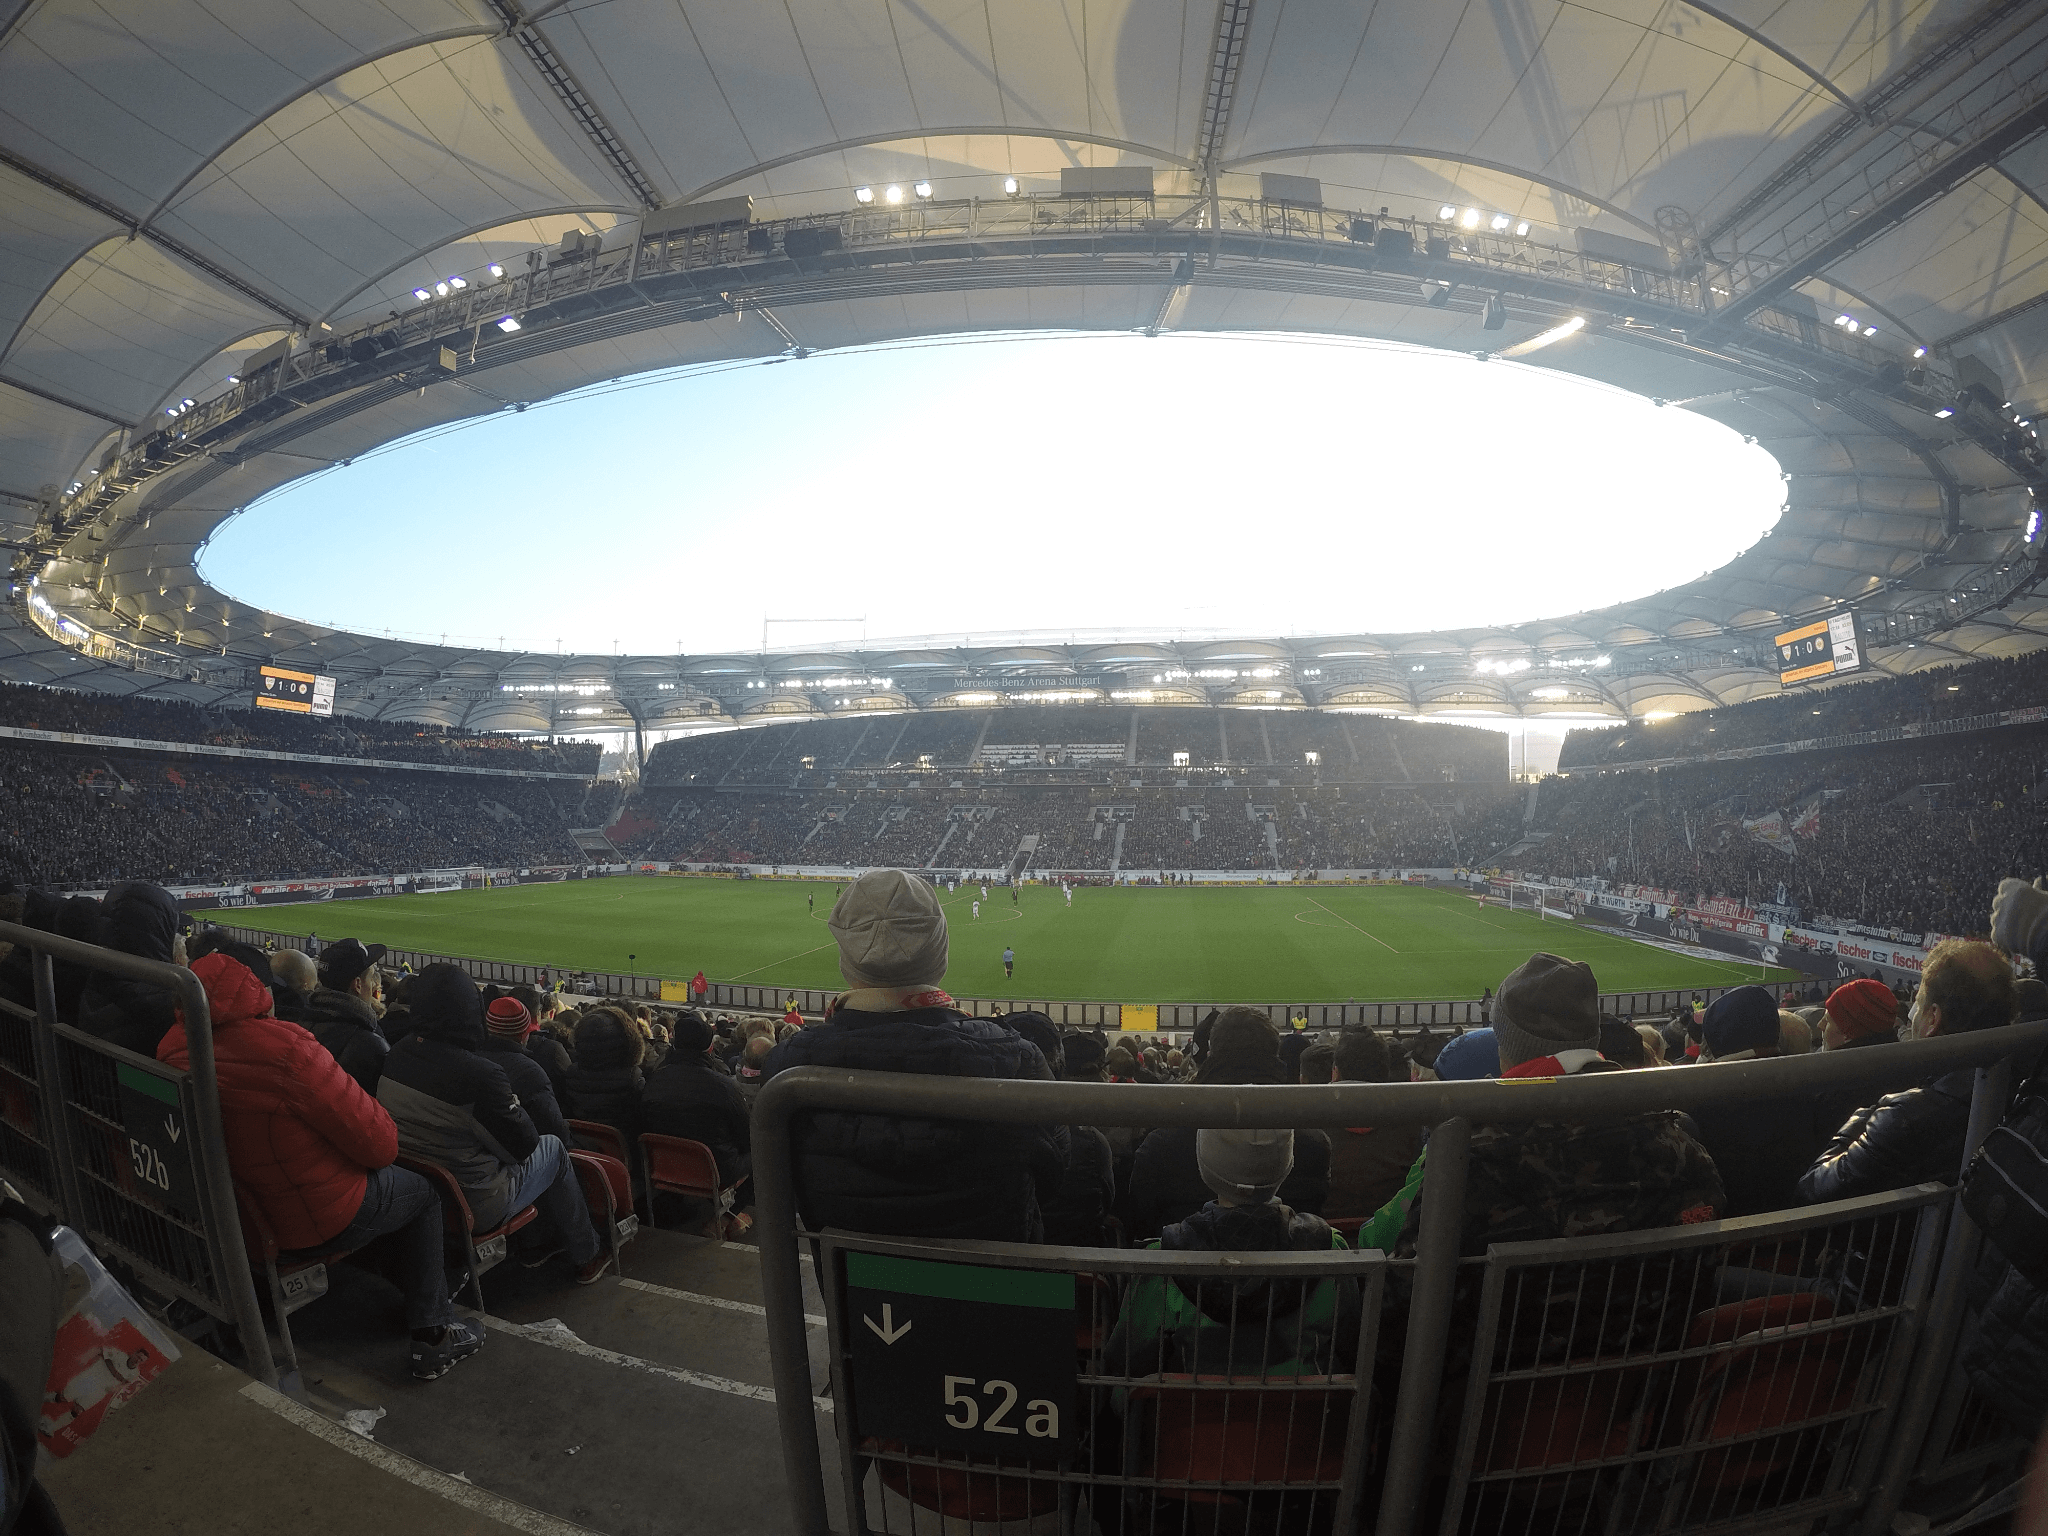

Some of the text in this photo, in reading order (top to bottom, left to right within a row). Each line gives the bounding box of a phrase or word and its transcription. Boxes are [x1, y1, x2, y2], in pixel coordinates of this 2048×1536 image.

[1835, 653, 1853, 665] PUMA
[953, 675, 1101, 688] Mercedes-Benz Arena Stuttgart
[18, 729, 52, 740] Krombacher
[88, 736, 119, 746] Krombacher
[138, 740, 168, 750] Krombacher
[244, 749, 269, 758] Krombacher
[297, 754, 321, 762] Krombacher
[185, 890, 215, 899] fischer
[372, 886, 381, 895] So
[382, 885, 393, 894] wie
[218, 894, 259, 908] So wie Du.
[1605, 897, 1626, 908] WÜRTH
[1736, 922, 1765, 937] dataTec
[1837, 940, 1872, 960] fischer
[1892, 951, 1924, 971] fische
[130, 1137, 169, 1191] 52b
[619, 1222, 630, 1234] 23
[479, 1244, 492, 1259] 24
[286, 1277, 304, 1295] 25
[943, 1374, 1059, 1439] 52a
